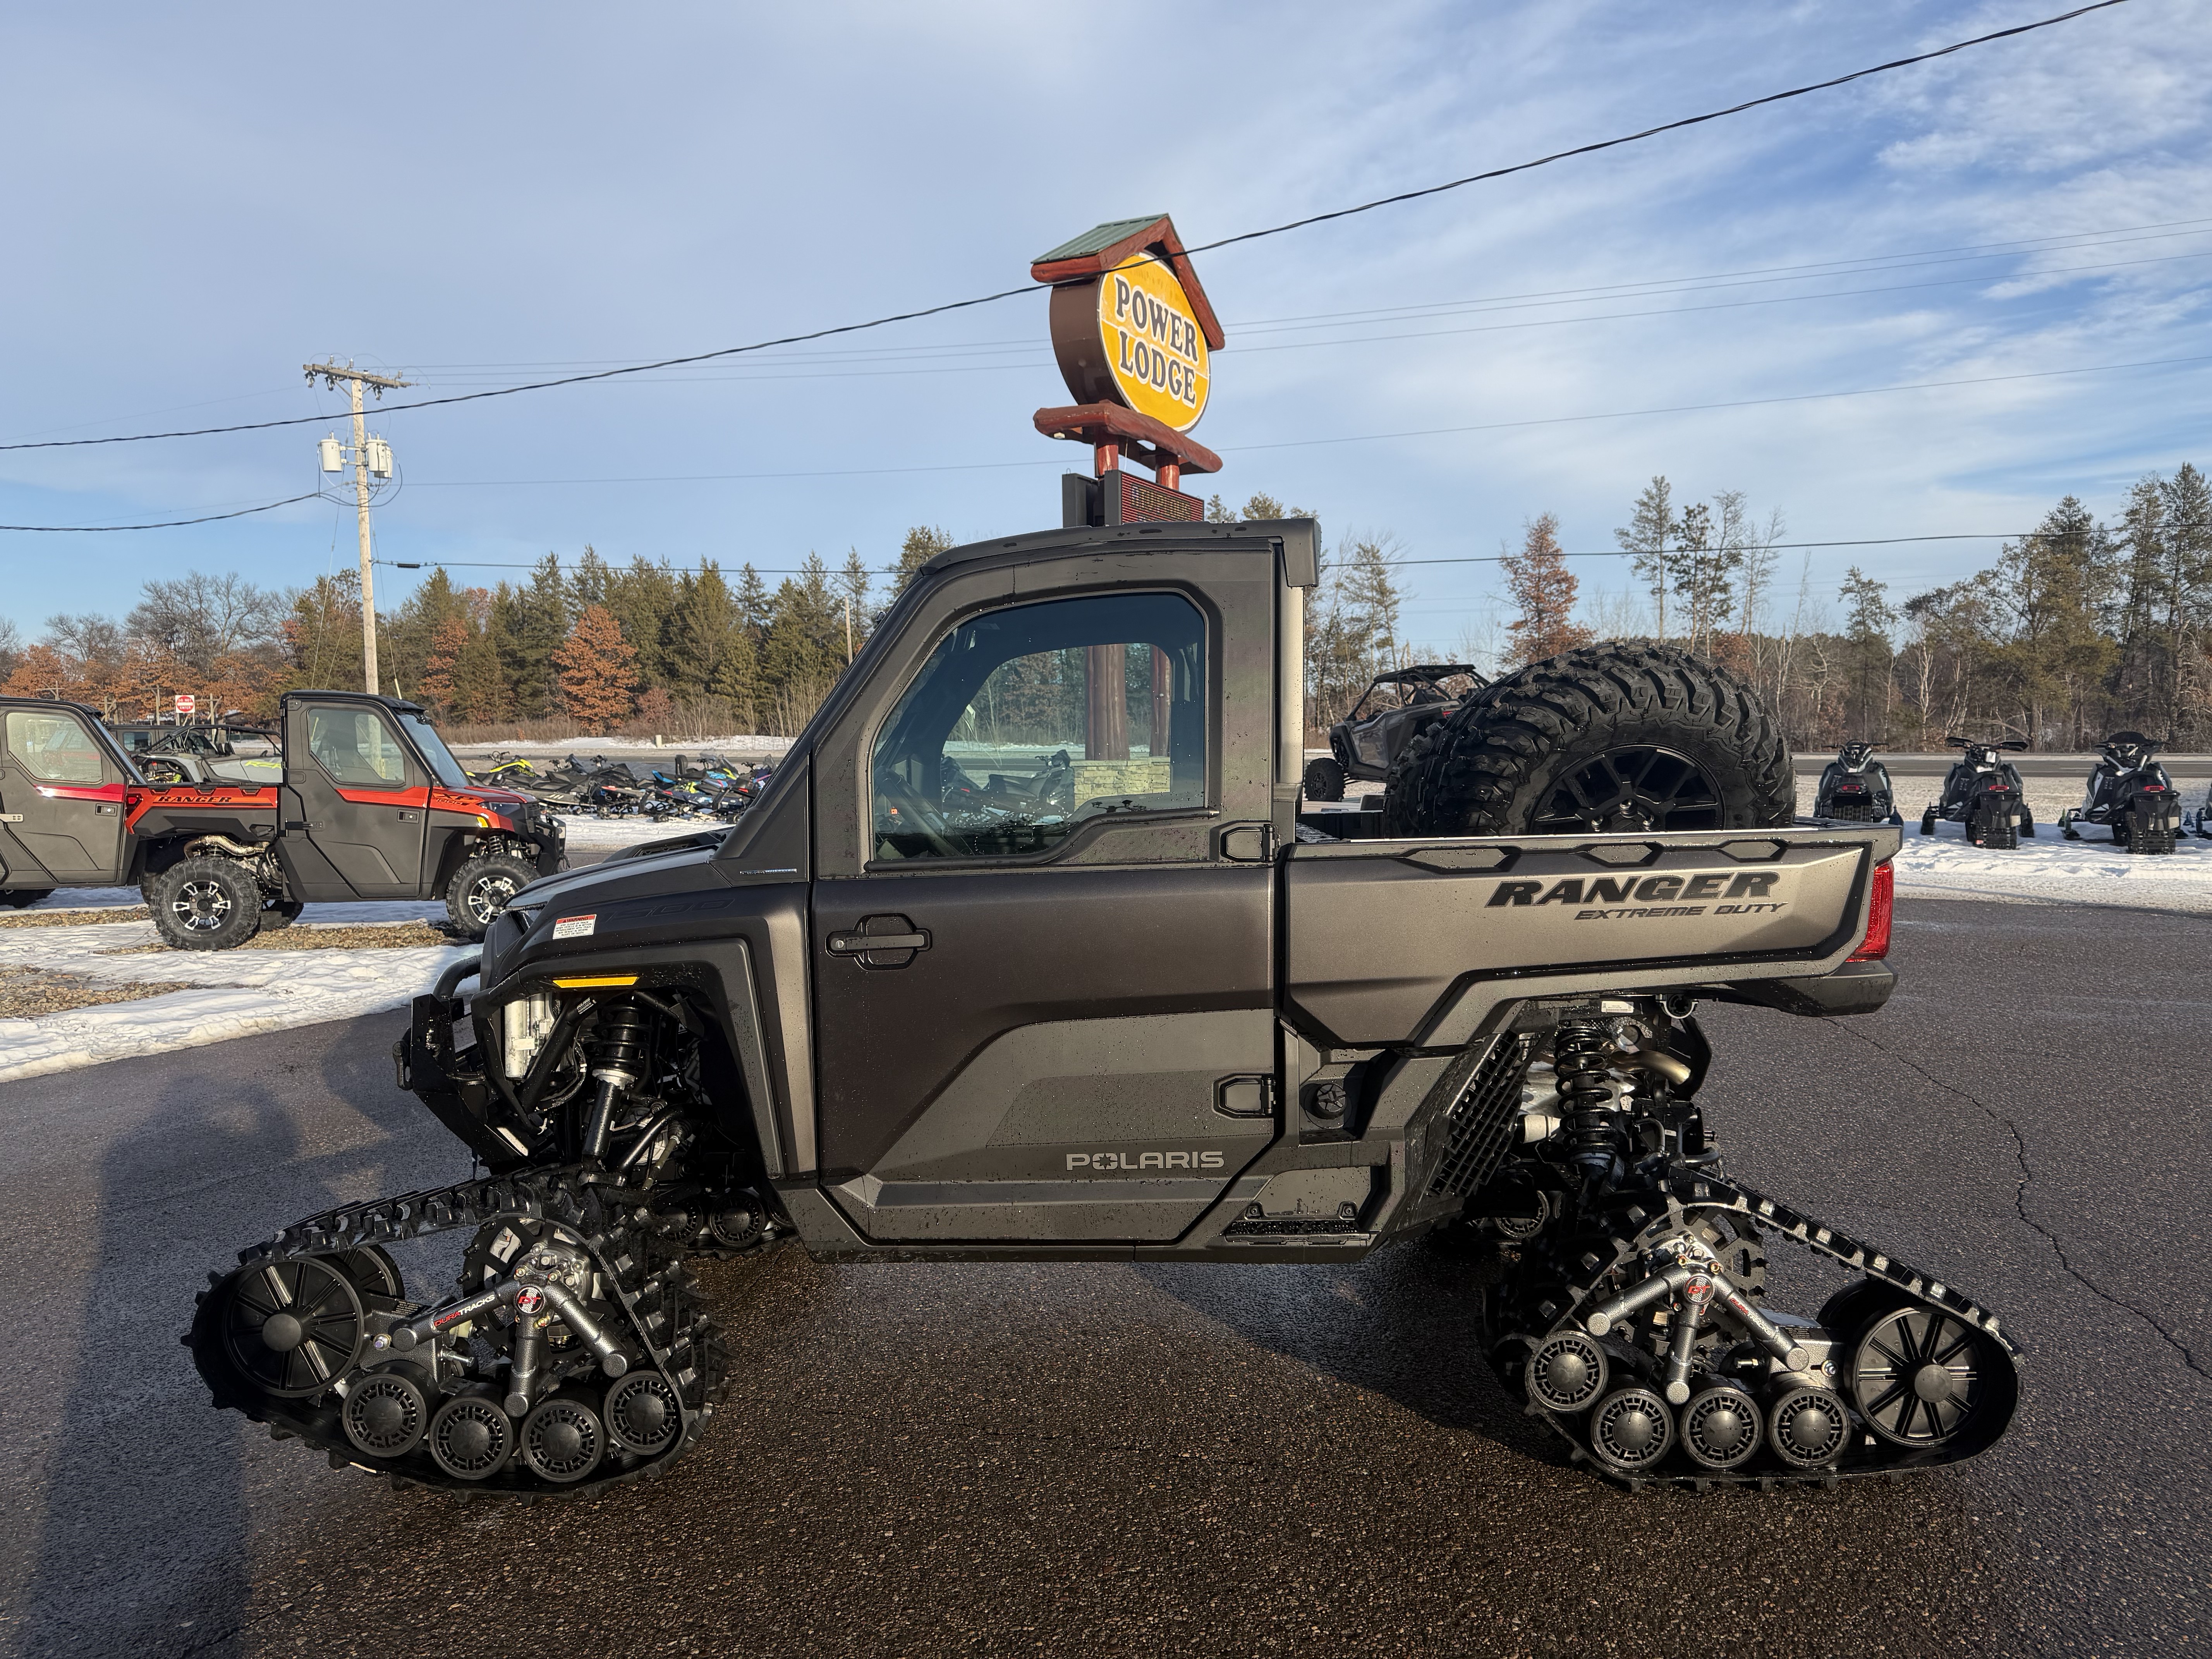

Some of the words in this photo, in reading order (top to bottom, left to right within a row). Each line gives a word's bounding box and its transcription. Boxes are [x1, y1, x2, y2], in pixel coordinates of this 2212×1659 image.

[1116, 277, 1197, 362] POWER
[1120, 330, 1195, 405] LODGE
[1484, 871, 1780, 908] RANGER
[1574, 905, 1707, 920] EXTREME
[1713, 902, 1789, 915] DUTY
[1066, 1151, 1224, 1171] POLARIS
[434, 1294, 495, 1327] DURATRACKS
[1730, 1298, 1775, 1336] DURATRACKS
